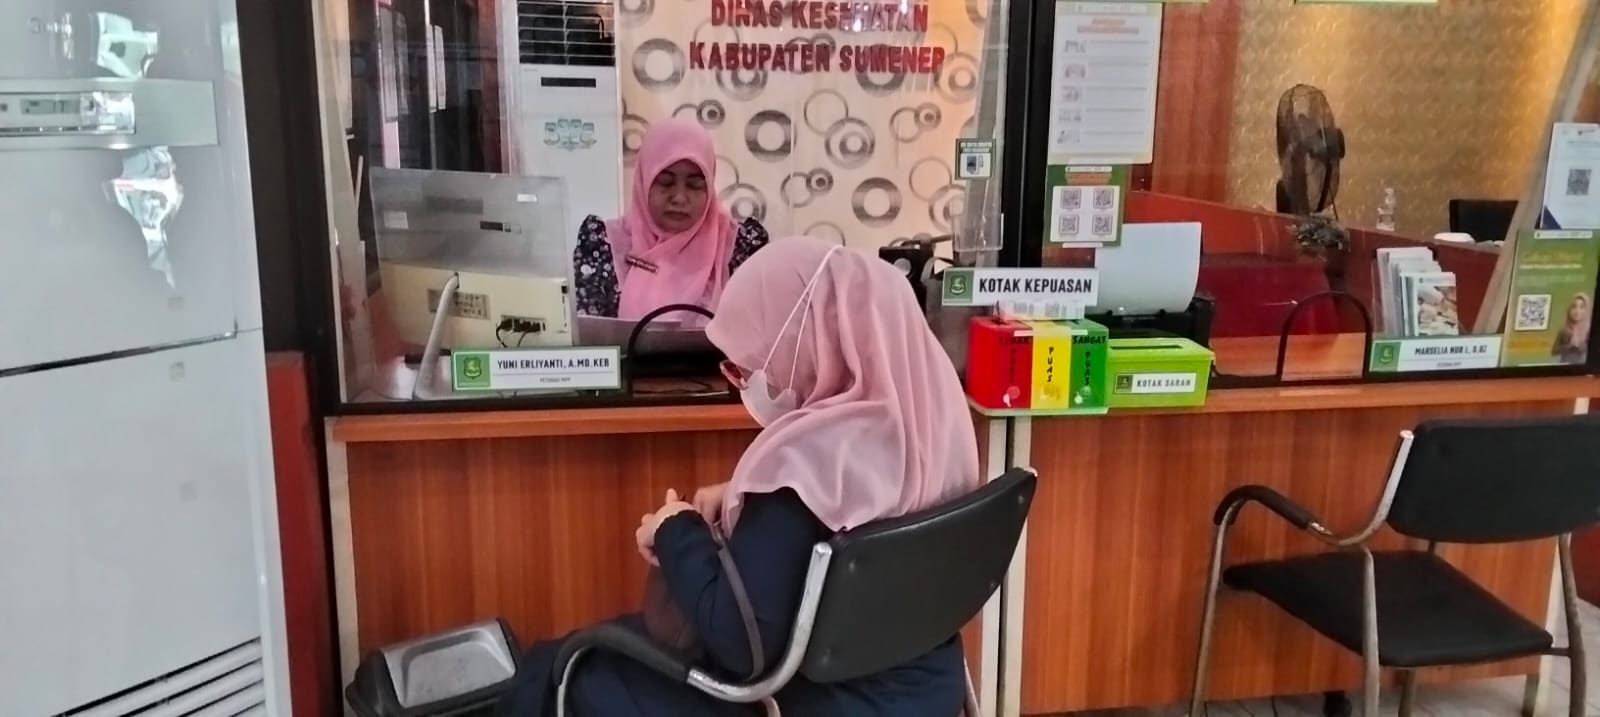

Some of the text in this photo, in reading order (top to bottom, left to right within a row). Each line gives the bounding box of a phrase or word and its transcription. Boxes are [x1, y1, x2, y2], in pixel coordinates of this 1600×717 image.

[711, 0, 928, 32] DINAS KESEHATAN
[689, 41, 945, 73] KABUPATEN SUMENEP
[979, 278, 1092, 293] KOTAK KEPUASAN
[1072, 335, 1107, 345] SANGAT
[497, 359, 518, 370] YUNI
[520, 358, 566, 370] ERLIYANTI,
[1046, 346, 1054, 382] PUAS
[1136, 379, 1161, 387] KOTAK
